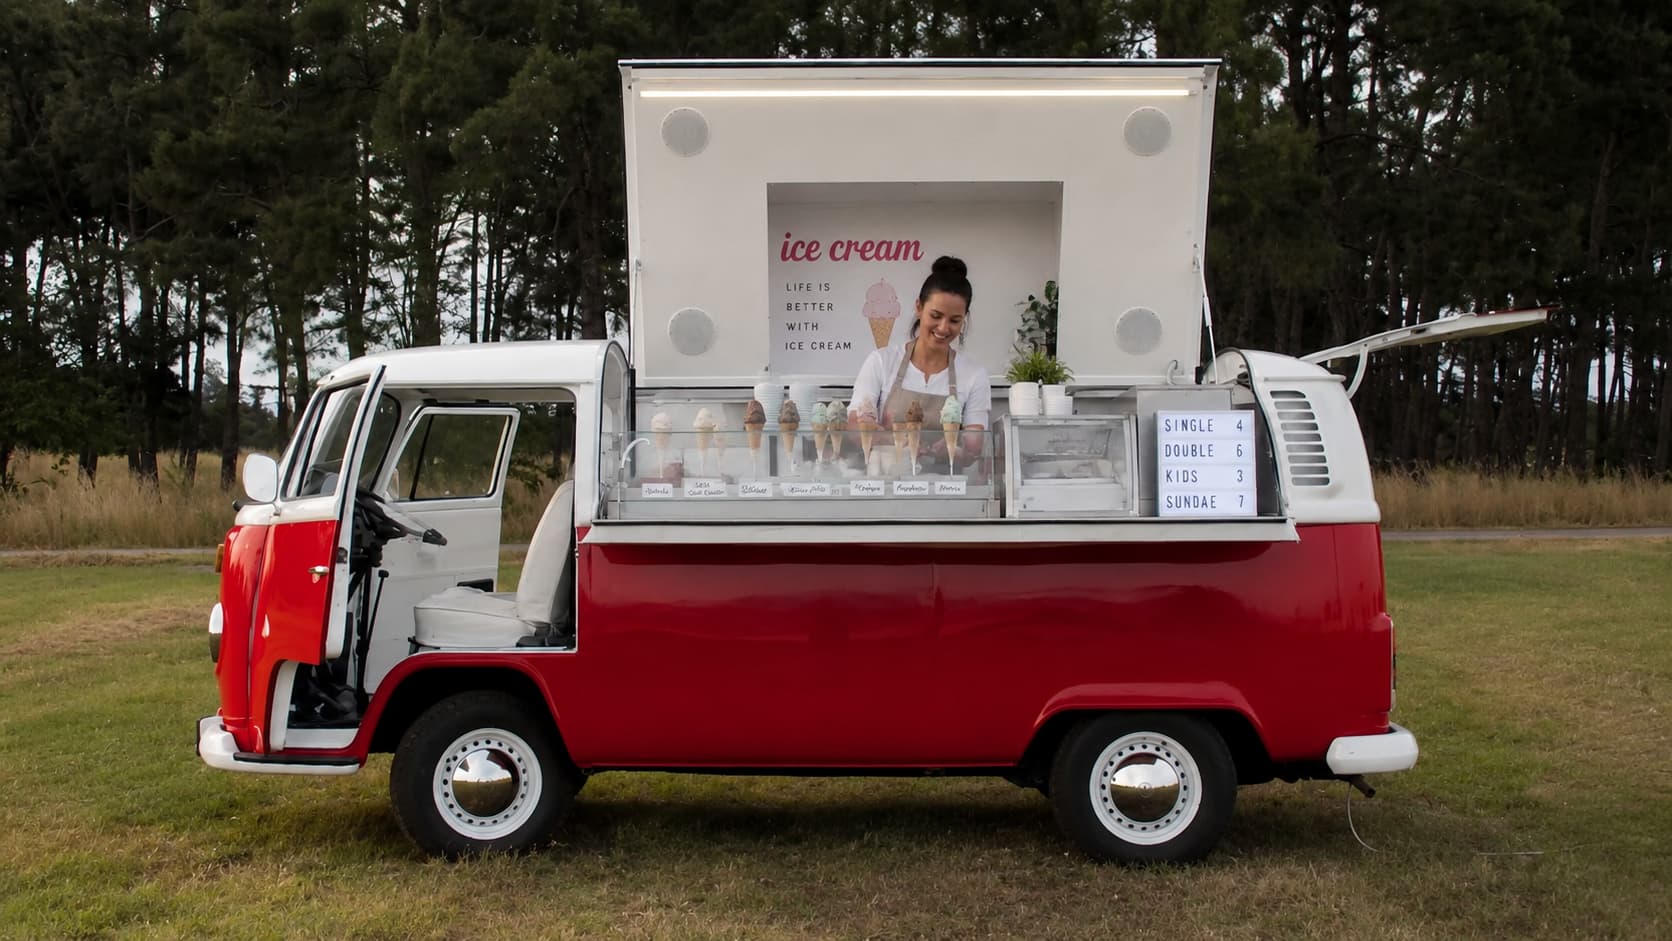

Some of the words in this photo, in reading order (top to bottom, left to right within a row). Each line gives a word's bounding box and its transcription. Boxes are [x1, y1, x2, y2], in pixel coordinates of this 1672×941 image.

[781, 232, 822, 262] ice
[829, 239, 924, 262] cream
[786, 283, 812, 292] LIFE
[819, 283, 831, 292] IS
[786, 302, 834, 311] BETTER
[786, 322, 819, 331] WITH
[785, 342, 804, 351] ICE
[810, 341, 852, 350] CREAM
[1164, 418, 1214, 432] SINGLE
[1236, 419, 1243, 432] 4
[1165, 444, 1215, 457] DOUBLE
[1236, 444, 1243, 457] 6
[1166, 469, 1198, 483] KIDS
[1237, 469, 1243, 482] 3
[1166, 495, 1217, 509] SUNDAE
[1239, 495, 1244, 508] 7
